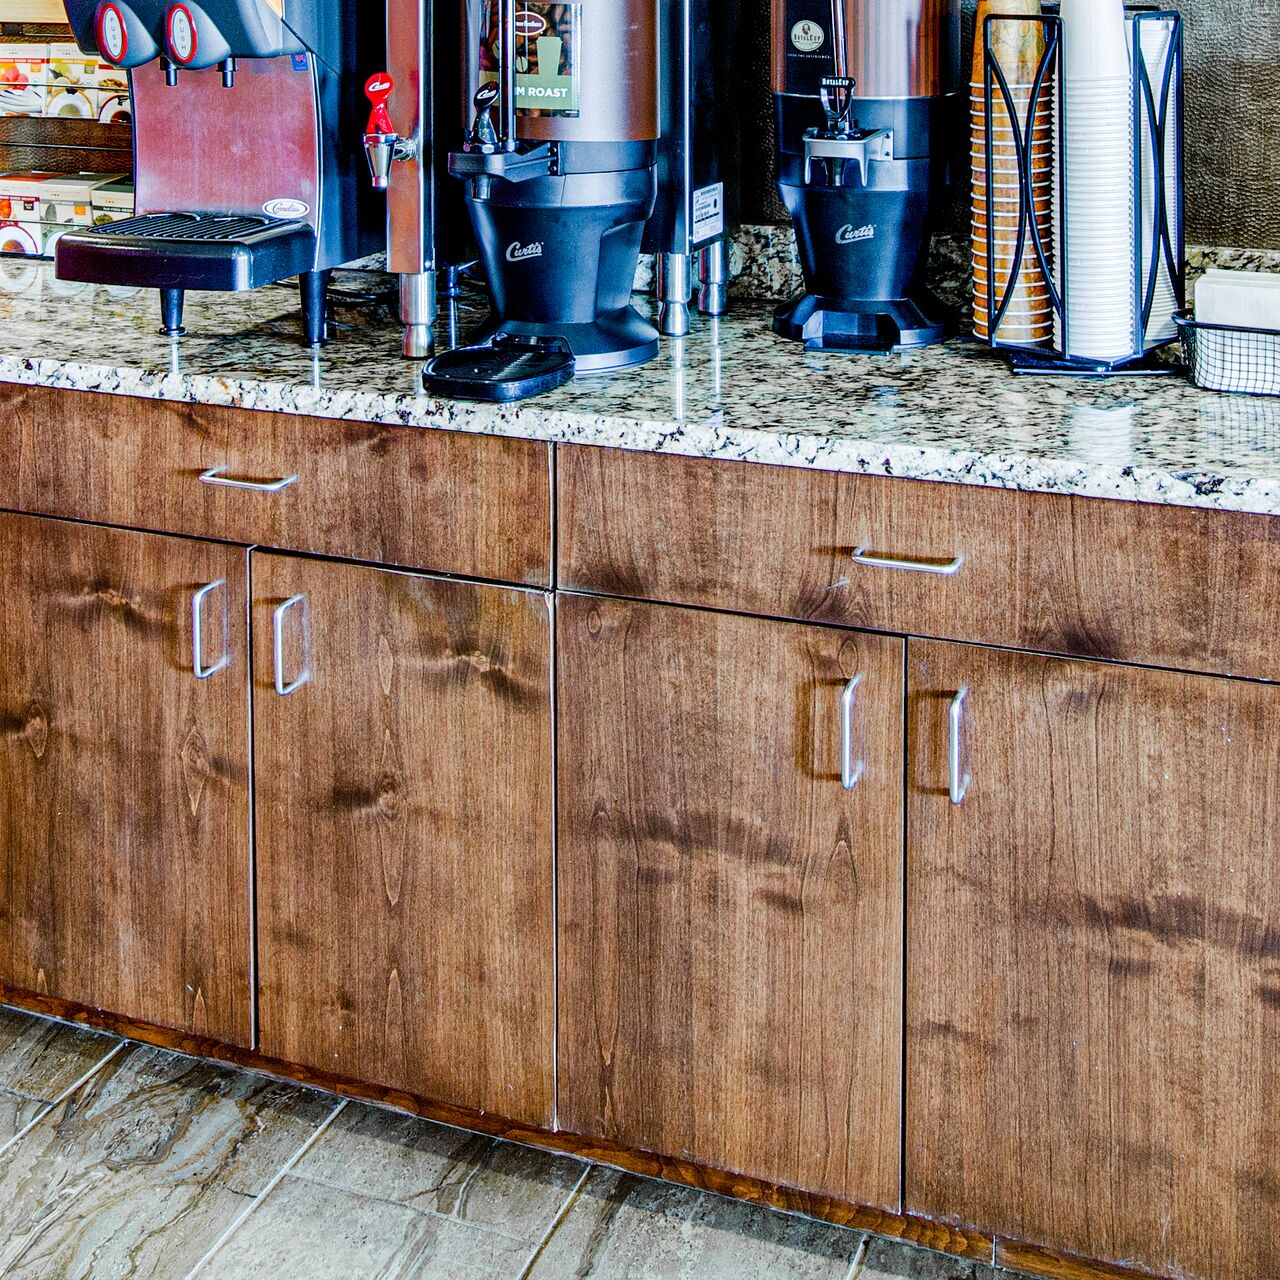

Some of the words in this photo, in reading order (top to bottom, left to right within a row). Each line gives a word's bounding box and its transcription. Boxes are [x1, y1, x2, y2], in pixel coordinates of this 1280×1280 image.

[109, 16, 118, 48] PUSH
[177, 18, 187, 50] PUSH
[528, 88, 568, 97] ROAST
[835, 224, 874, 244] Curtis
[505, 241, 543, 261] Curtis
